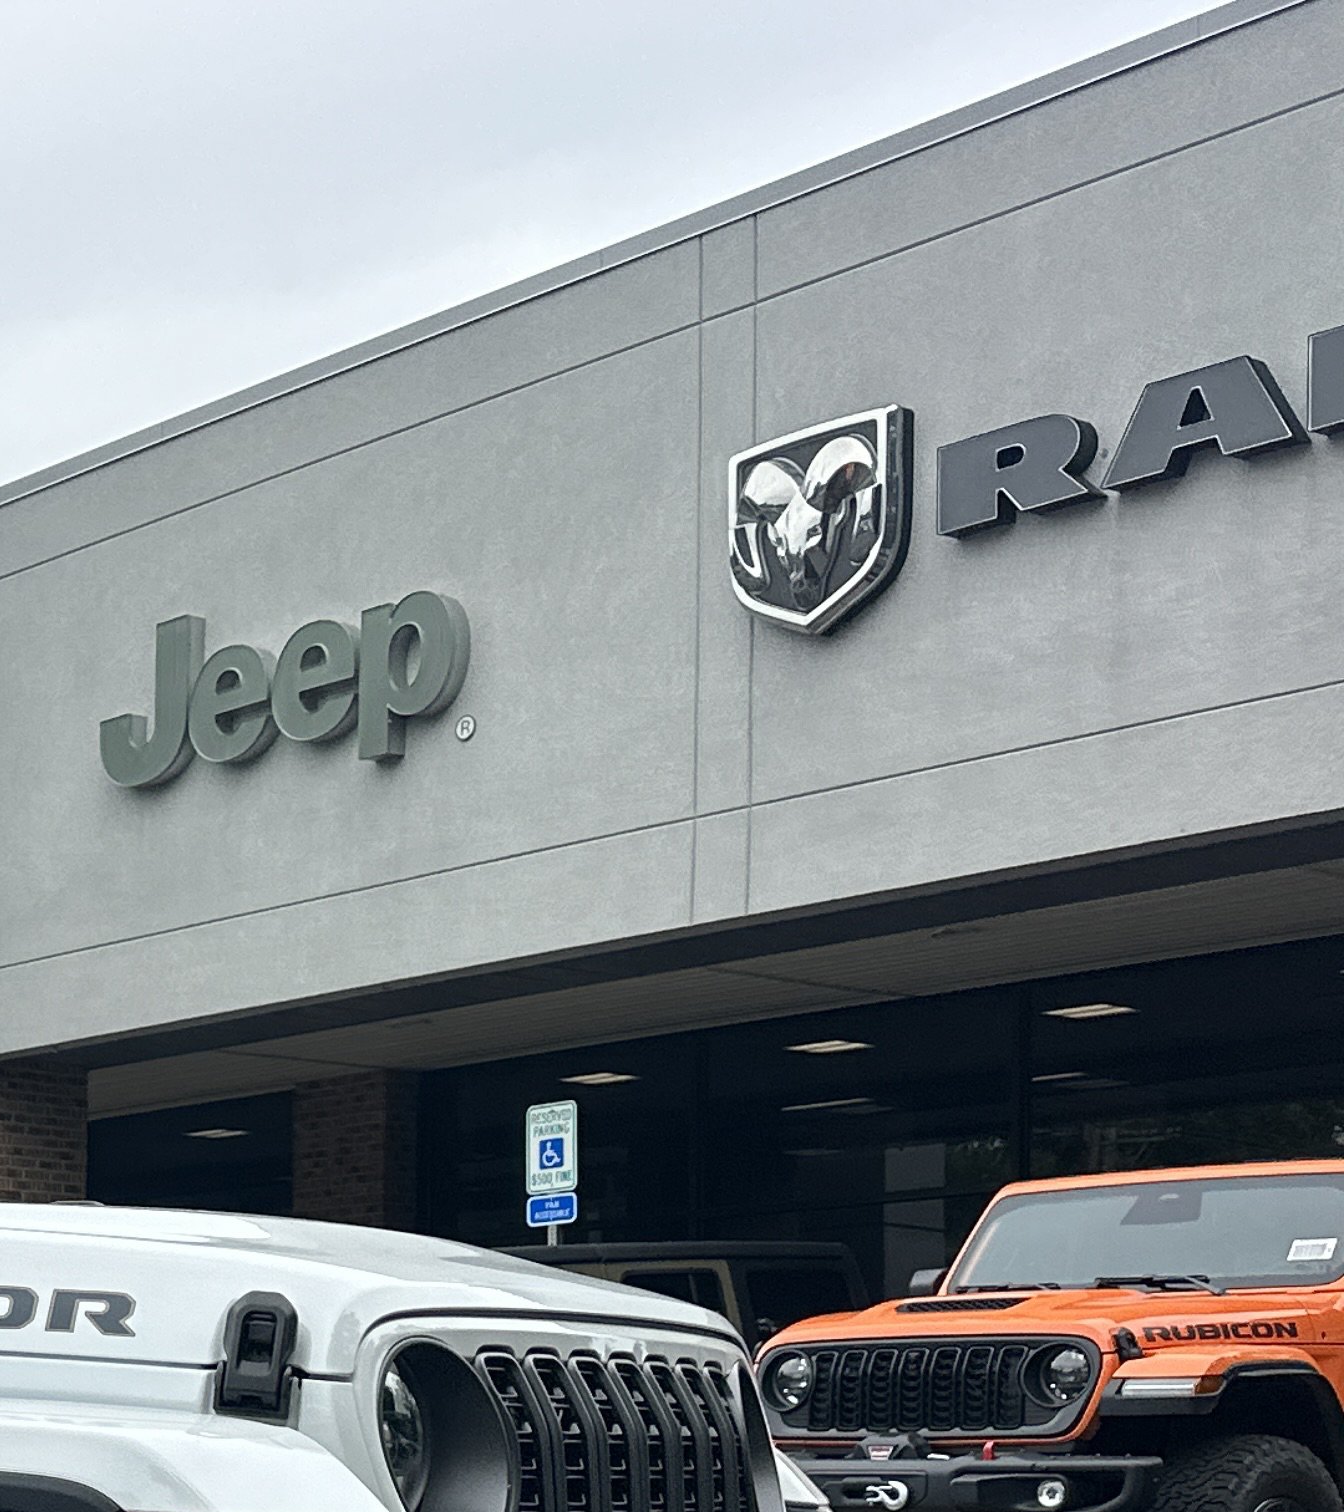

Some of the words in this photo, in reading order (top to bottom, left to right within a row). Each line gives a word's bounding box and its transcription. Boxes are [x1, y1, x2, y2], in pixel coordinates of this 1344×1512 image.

[937, 325, 1344, 537] RA
[100, 590, 470, 788] Jeep
[531, 1109, 572, 1124] RESERVED
[533, 1121, 570, 1137] PARKING
[1142, 1322, 1298, 1342] RUBICON
